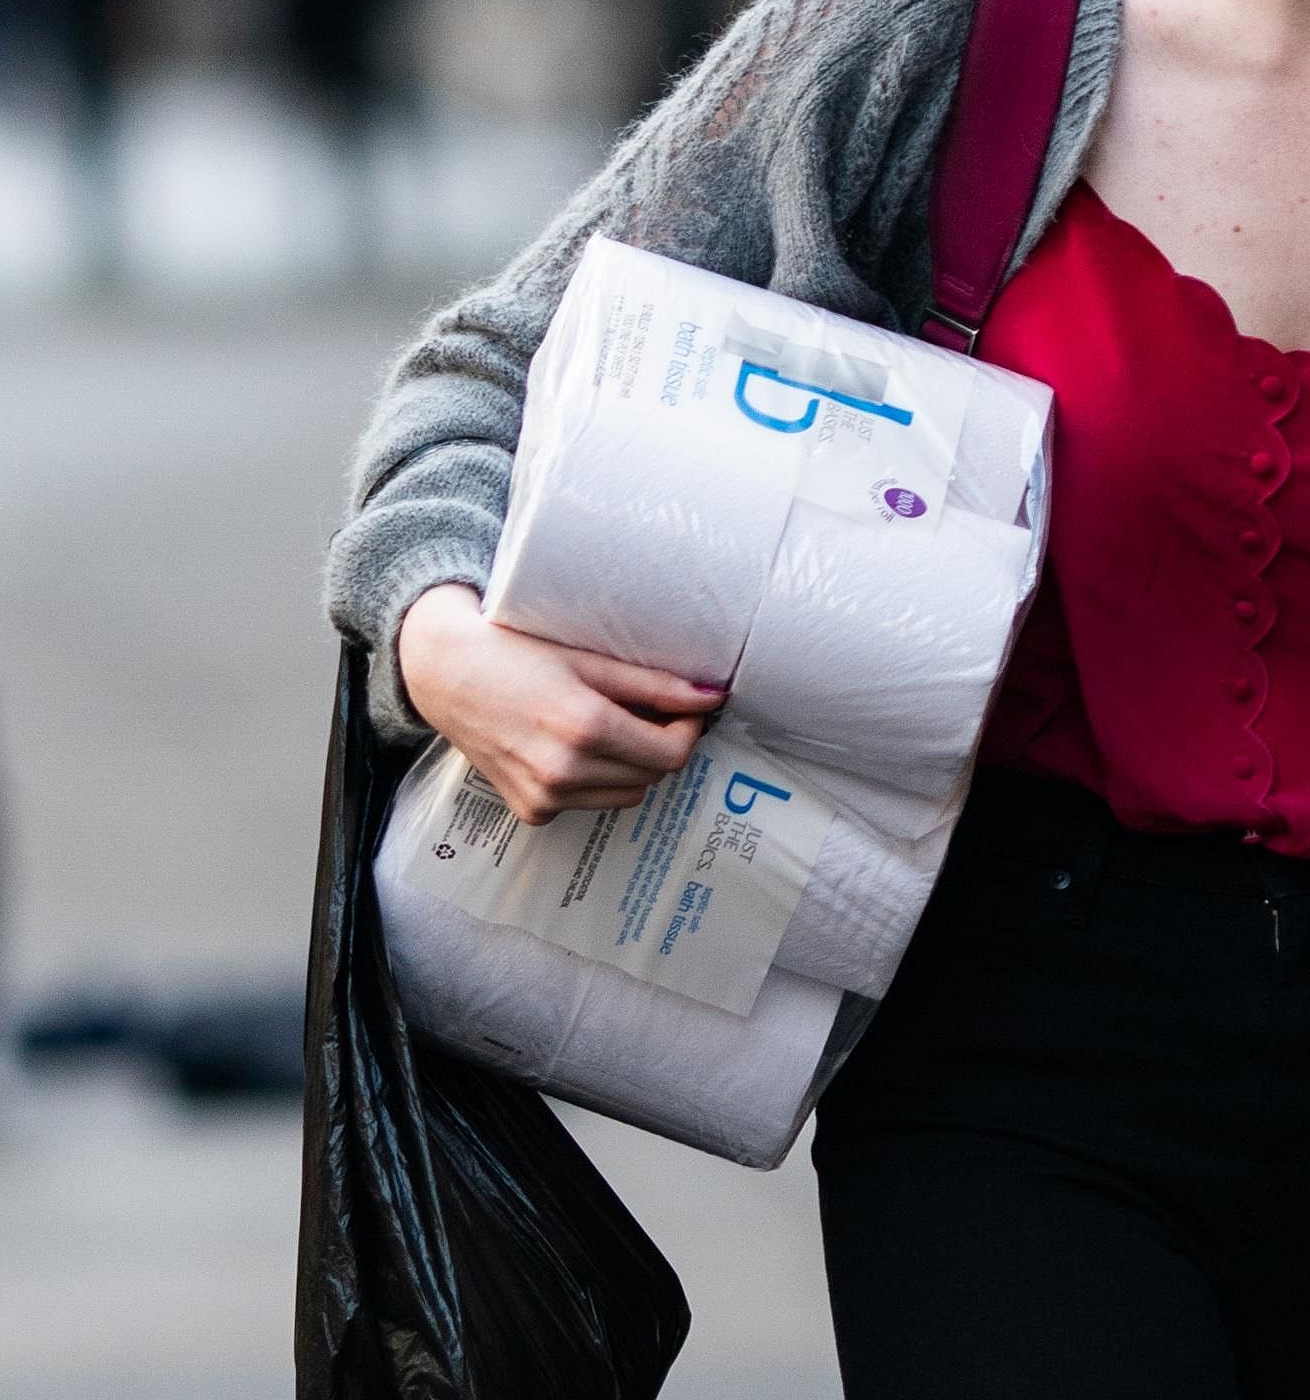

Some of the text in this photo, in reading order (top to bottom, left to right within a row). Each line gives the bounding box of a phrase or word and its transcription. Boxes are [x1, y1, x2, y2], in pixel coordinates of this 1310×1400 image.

[661, 321, 703, 408] bath tissue
[724, 820, 746, 851] THE
[739, 824, 763, 864] JUST
[660, 881, 703, 956] bath tissue
